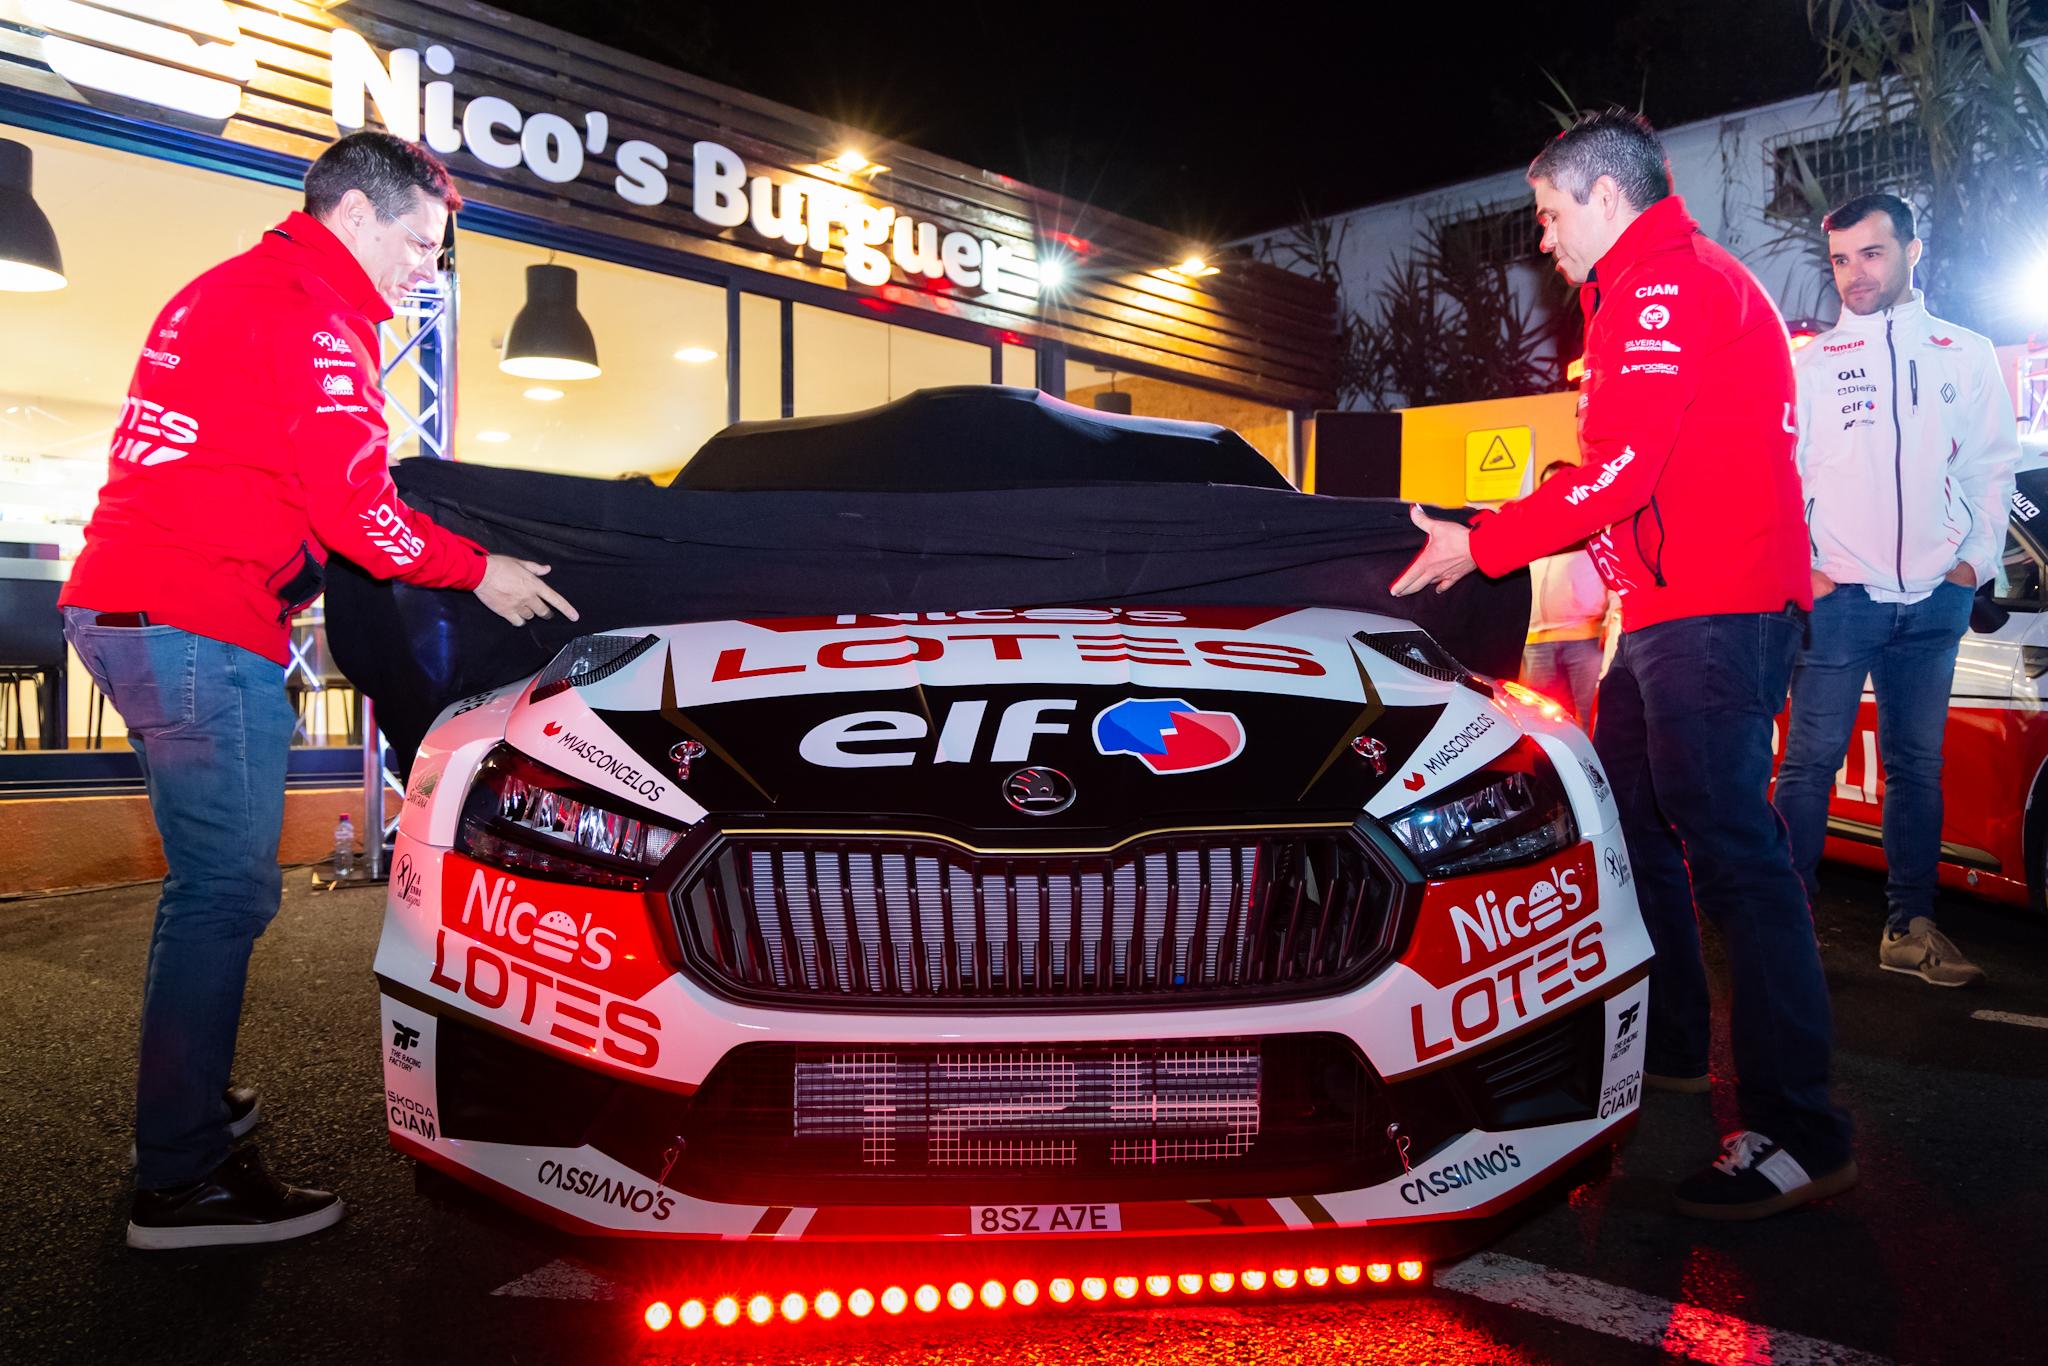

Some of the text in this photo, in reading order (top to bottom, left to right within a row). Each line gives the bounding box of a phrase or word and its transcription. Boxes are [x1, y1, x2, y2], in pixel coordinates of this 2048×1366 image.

[332, 27, 1016, 293] Nico's Burguer
[1635, 284, 1679, 298] CIAM
[1838, 368, 1866, 380] OLI
[1842, 400, 1863, 414] elf
[2011, 490, 2041, 518] AUTO
[711, 634, 1327, 682] LOTES
[799, 700, 1078, 768] elf
[1423, 713, 1496, 776] MVASCONCELOS
[558, 732, 666, 802] MVASCONCELOS
[462, 868, 617, 971] Nico's
[1449, 866, 1582, 964] Nico's
[430, 929, 662, 1068] LOTES
[1410, 921, 1607, 1063] LOTES
[388, 1056, 413, 1073] FACTORY
[391, 1048, 422, 1069] THE RACING
[390, 1106, 436, 1142] CIAM
[1600, 1084, 1638, 1120] CIAM
[538, 1160, 676, 1221] CASSIANO'S
[1400, 1143, 1521, 1205] CASSIANO'S
[980, 1206, 1109, 1232] 8SZ A7E
